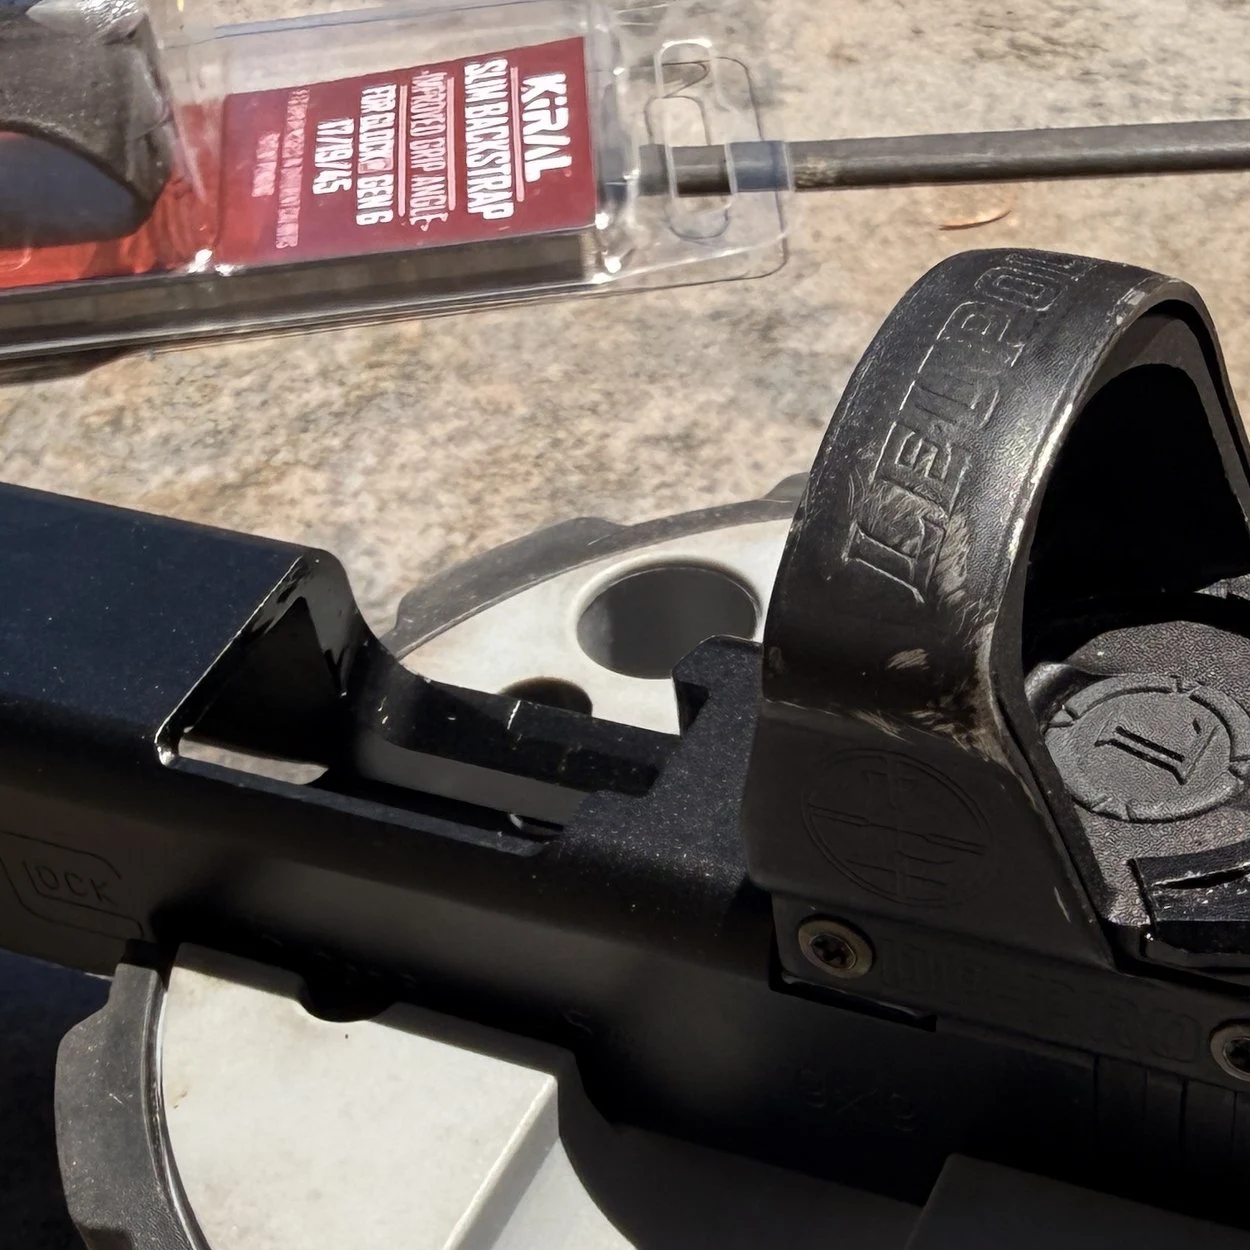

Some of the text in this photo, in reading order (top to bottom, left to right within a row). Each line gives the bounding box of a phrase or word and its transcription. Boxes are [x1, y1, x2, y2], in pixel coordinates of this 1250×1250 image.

[360, 84, 397, 114] FOR
[409, 136, 446, 172] GRIP
[464, 58, 515, 220] SLIM BACKSTRAP
[356, 173, 394, 210] GEN
[355, 208, 393, 226] 6
